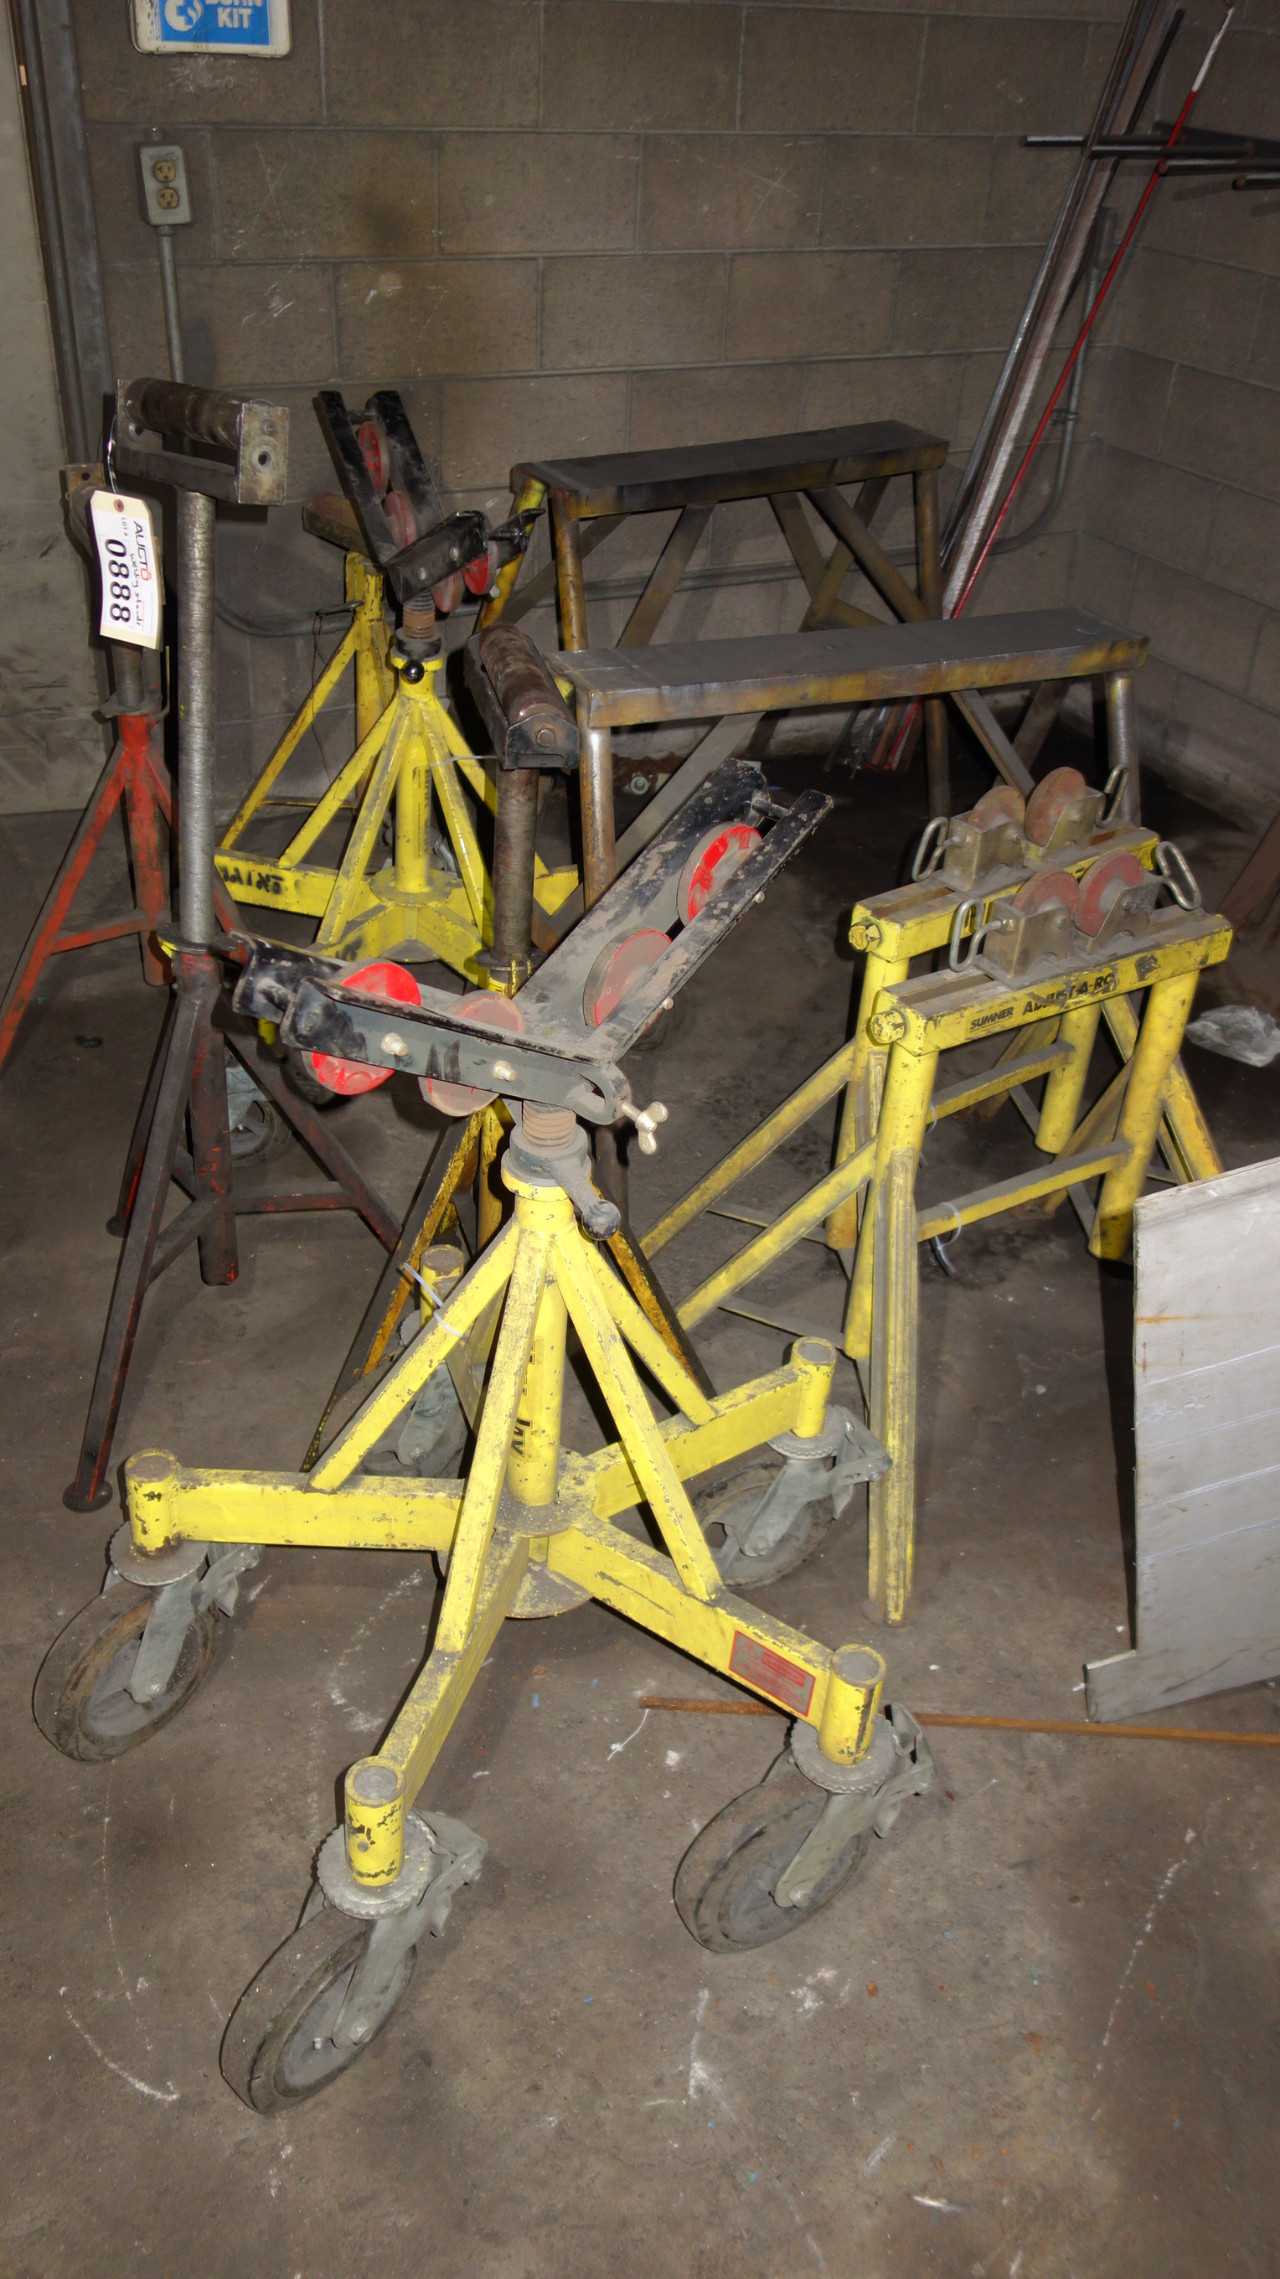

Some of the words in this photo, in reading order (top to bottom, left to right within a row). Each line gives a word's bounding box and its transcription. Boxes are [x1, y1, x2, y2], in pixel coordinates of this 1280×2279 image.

[217, 7, 252, 29] KIT
[105, 538, 131, 623] 0888
[970, 1006, 1015, 1030] SUMNER
